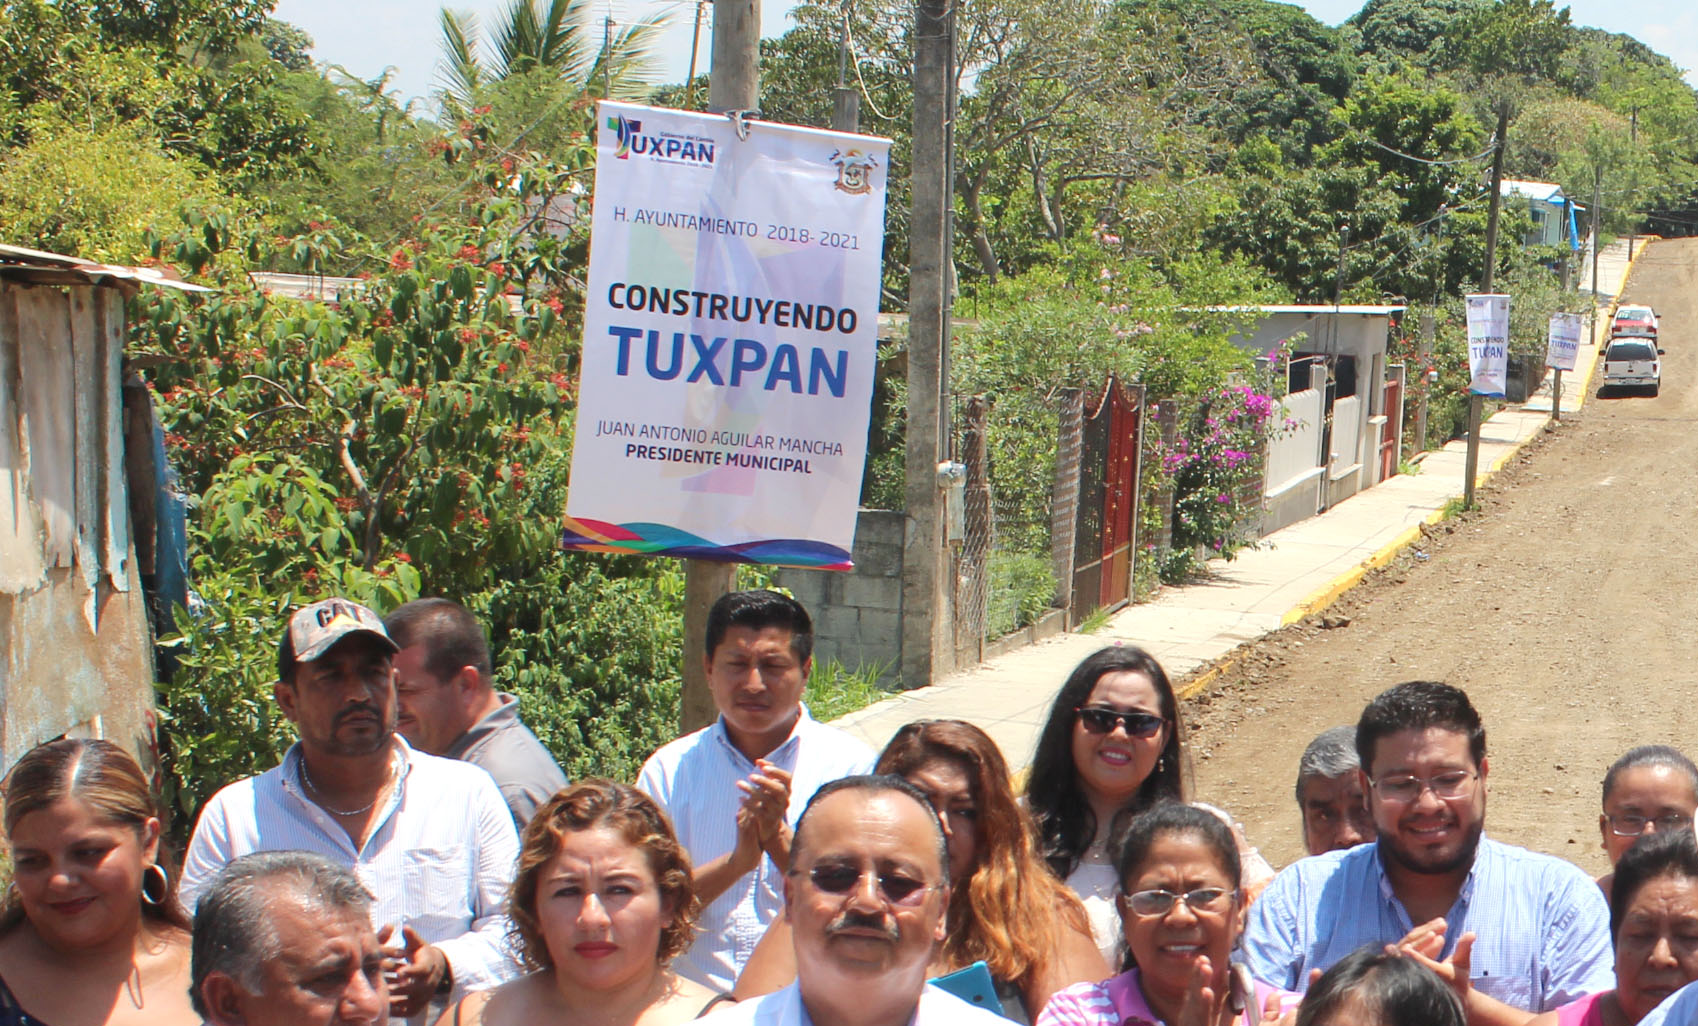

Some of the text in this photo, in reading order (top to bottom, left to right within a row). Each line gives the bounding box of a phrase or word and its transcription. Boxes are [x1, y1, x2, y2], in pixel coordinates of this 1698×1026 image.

[614, 206, 629, 222] H.
[634, 209, 758, 237] AYUNTAMIENTO
[819, 231, 859, 250] 2021
[608, 282, 857, 334] CONSTRUYENDO
[608, 325, 849, 398] TUXPAN
[596, 420, 844, 456] JUAN ANTONIO AGUILAR MANCHA
[626, 443, 812, 474] PRESIDENTE MUNICIPAL
[316, 603, 362, 628] CAT
